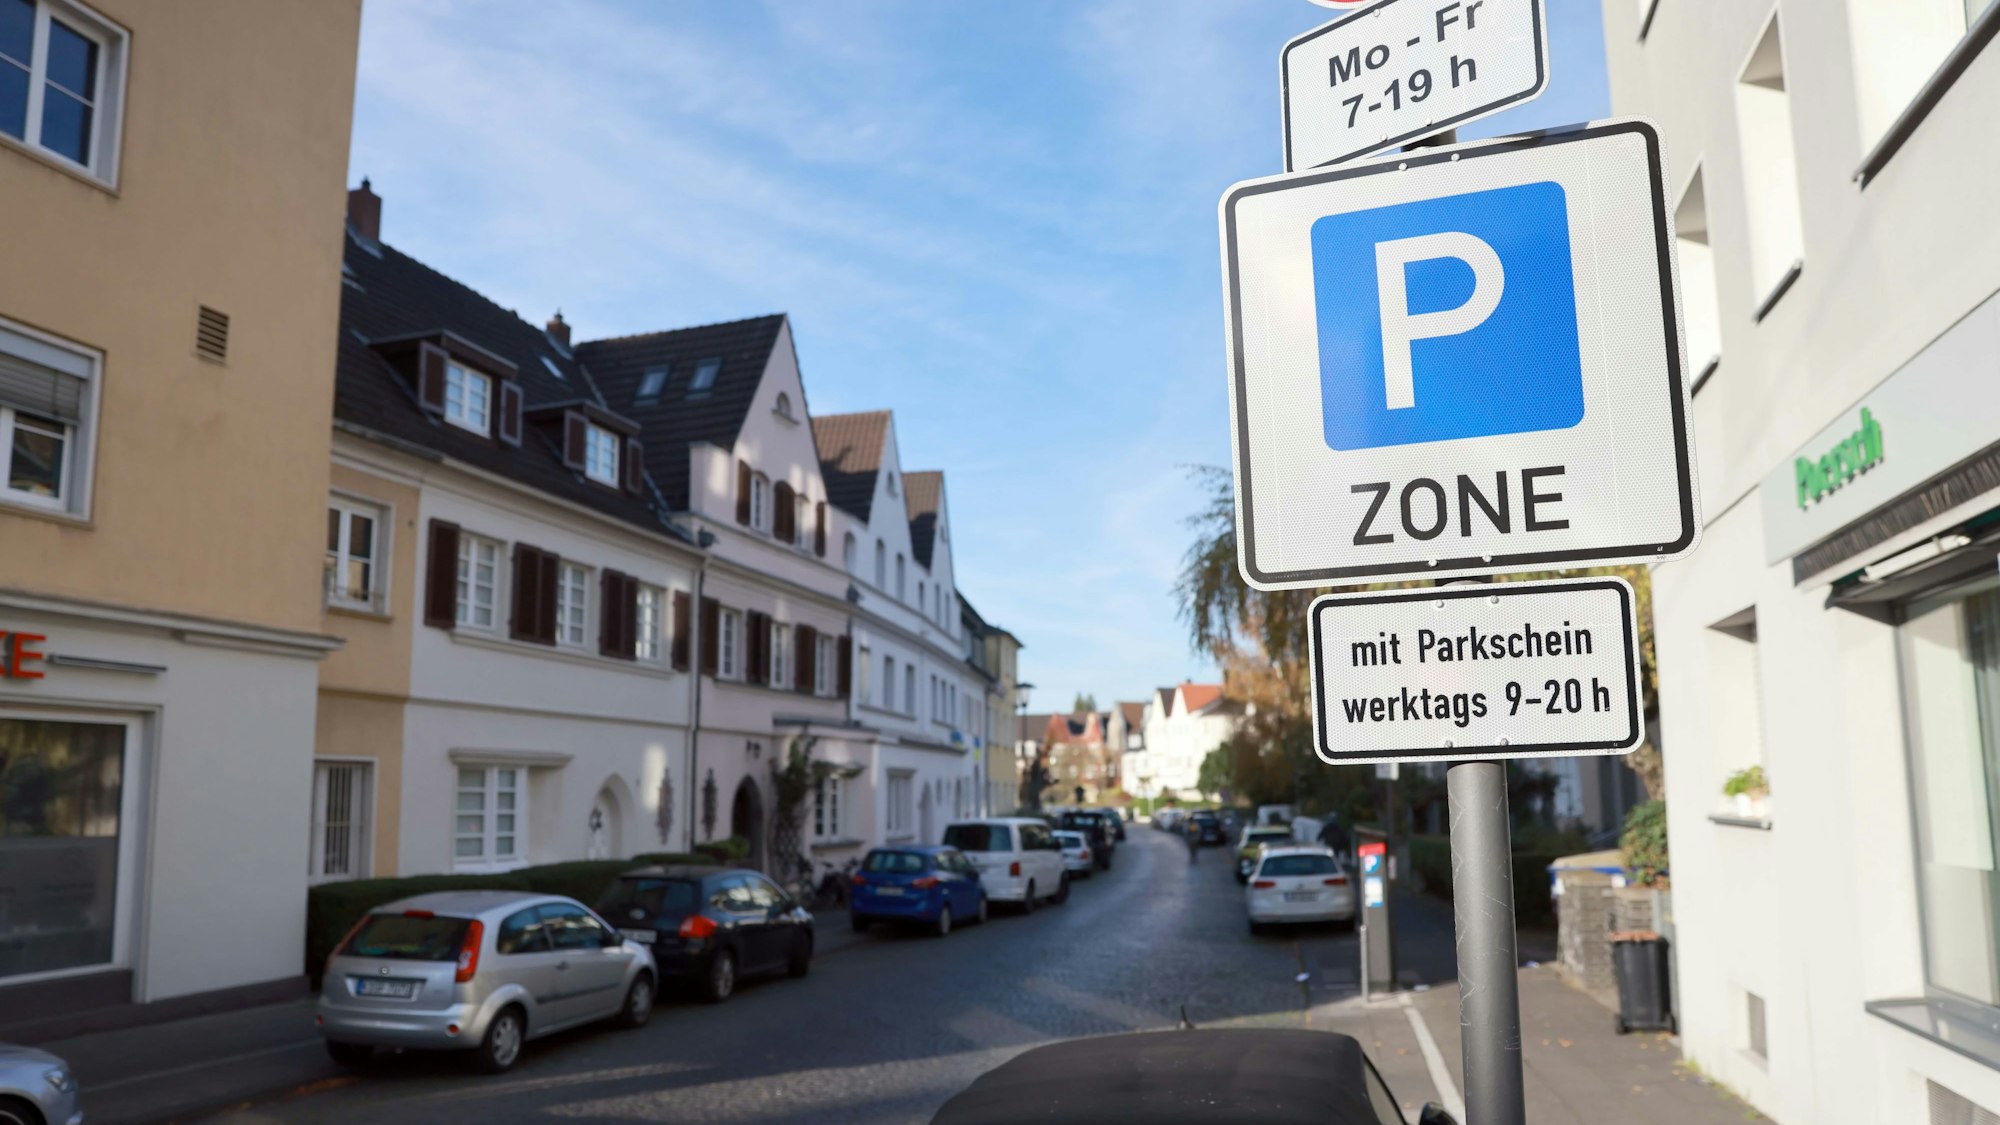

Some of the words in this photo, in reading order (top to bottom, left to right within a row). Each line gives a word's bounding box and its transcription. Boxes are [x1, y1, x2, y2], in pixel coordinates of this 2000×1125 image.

[1328, 44, 1390, 88] Mo
[1435, 0, 1484, 43] Fr
[1342, 68, 1433, 129] 7-19
[1450, 54, 1477, 89] h
[1374, 230, 1506, 411] P
[1350, 465, 1570, 546] ZONE
[1351, 631, 1402, 667] mit
[1418, 620, 1593, 663] Parkschein
[1342, 686, 1488, 728] werktags
[1591, 676, 1611, 712] h
